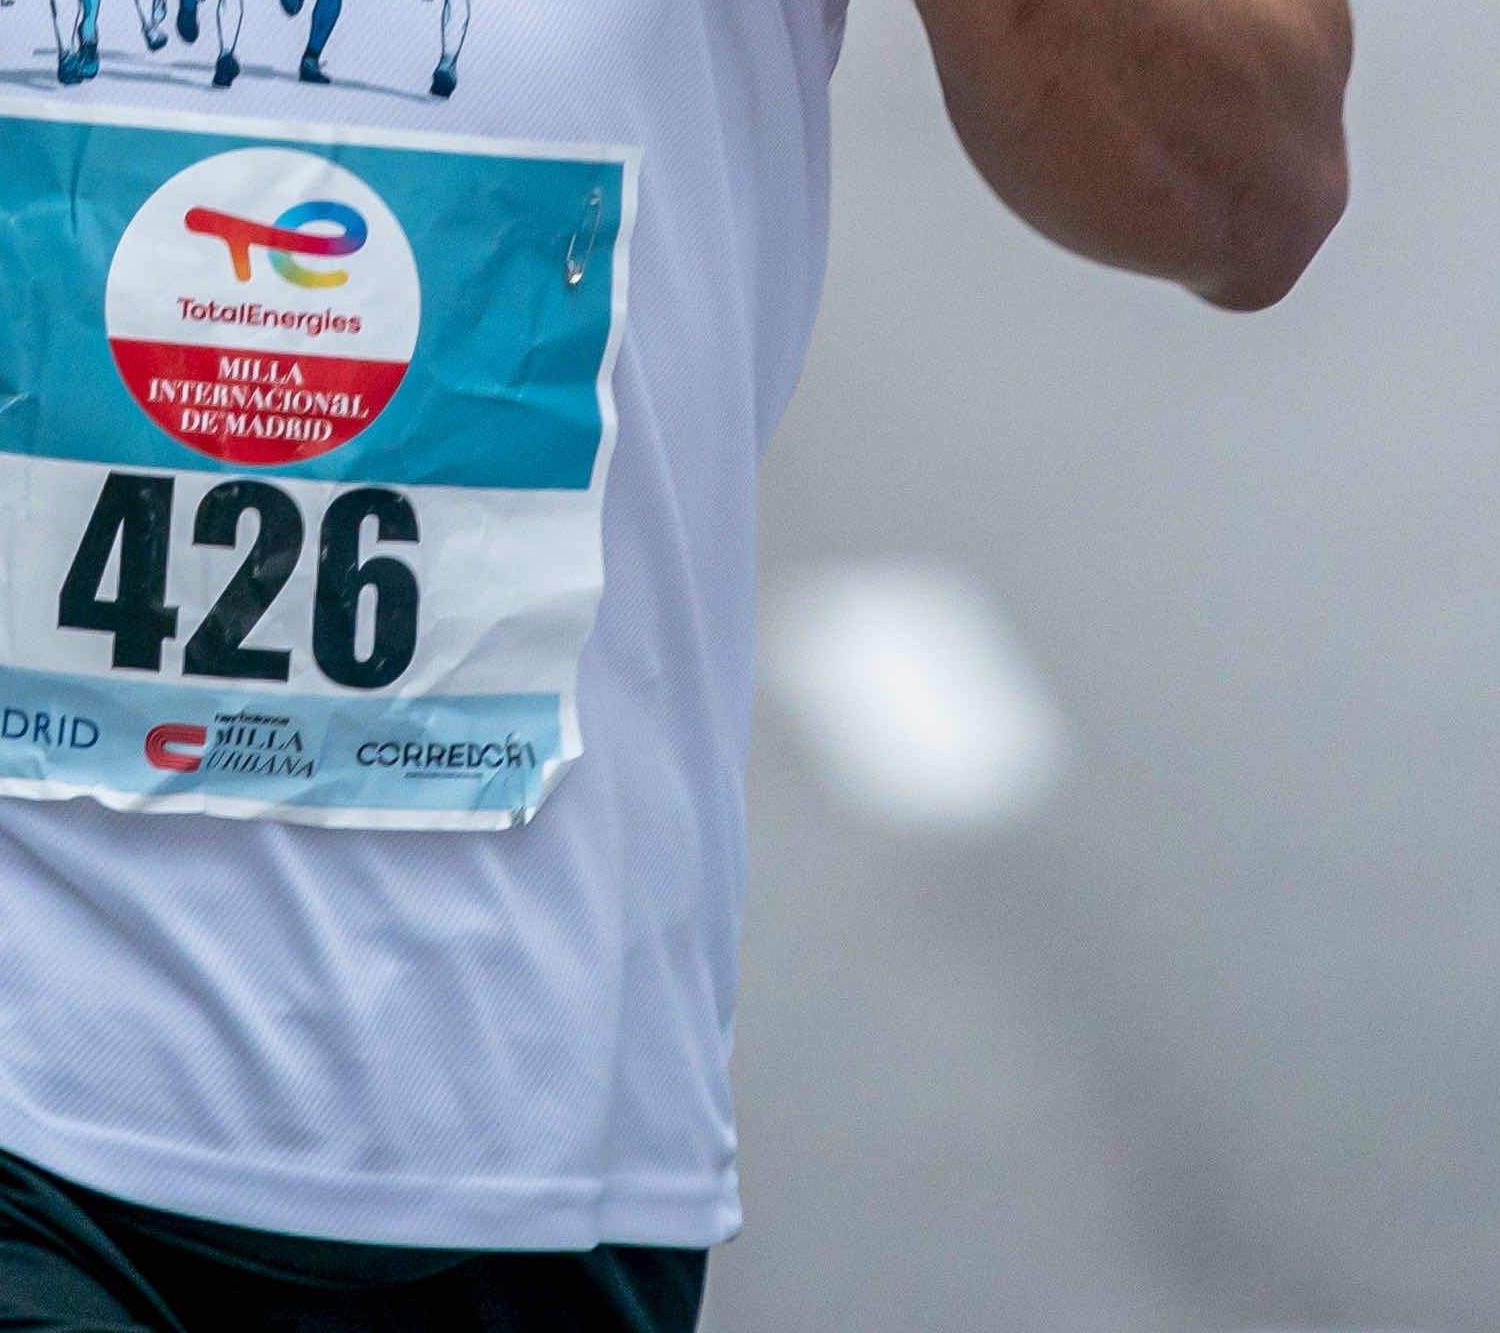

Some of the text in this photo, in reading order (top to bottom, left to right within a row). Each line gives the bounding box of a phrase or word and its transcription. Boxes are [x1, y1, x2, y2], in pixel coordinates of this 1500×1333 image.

[177, 296, 363, 337] TotalEnergies
[217, 356, 305, 385] MILLA
[180, 408, 334, 442] DE MADRID
[57, 470, 420, 689] 426
[214, 725, 303, 753] MILLA
